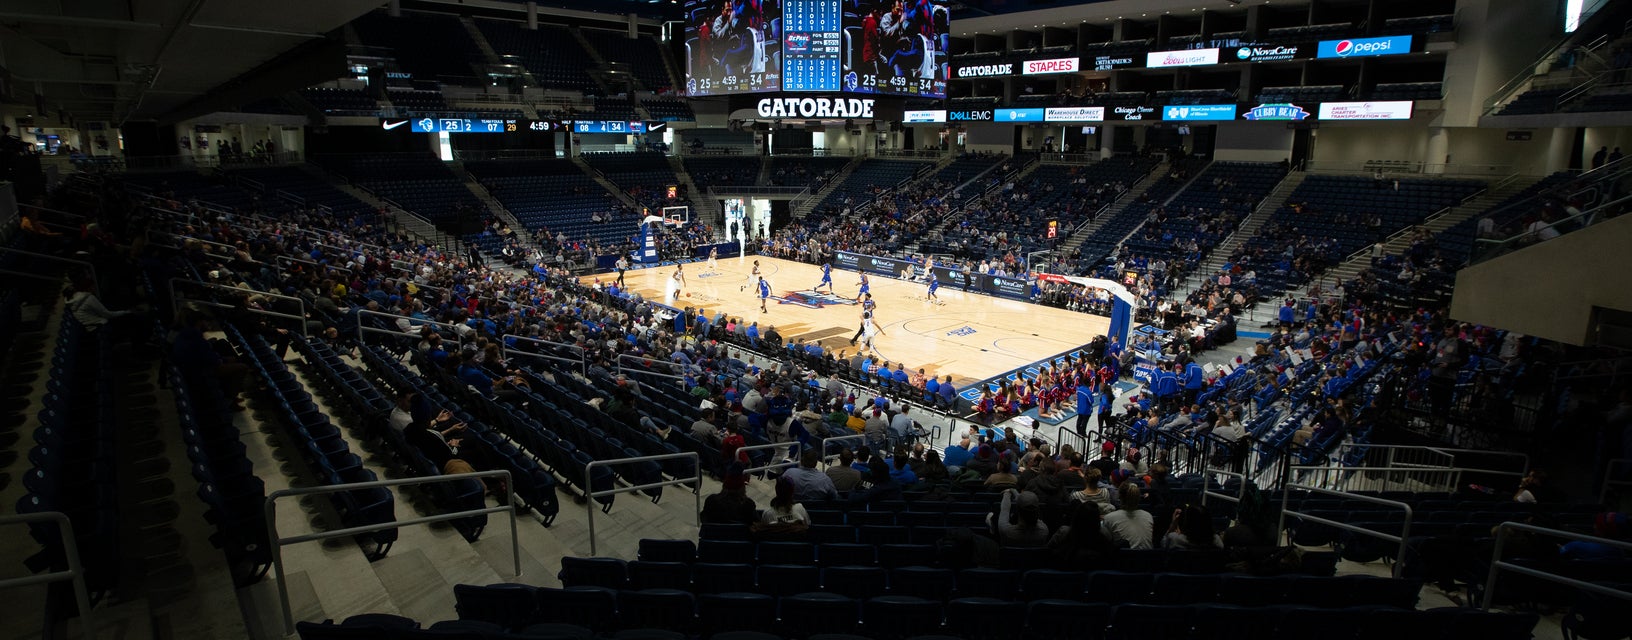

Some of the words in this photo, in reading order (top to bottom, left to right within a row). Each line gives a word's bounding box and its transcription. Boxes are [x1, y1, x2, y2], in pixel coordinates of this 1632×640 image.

[1251, 46, 1297, 56] NovaCare
[1354, 40, 1391, 53] pepsi
[958, 64, 1012, 77] GATORADE
[1030, 60, 1072, 72] STAPLES
[700, 78, 710, 88] 25
[722, 76, 736, 84] 4:59
[750, 74, 762, 86] 34
[862, 74, 876, 86] 25
[890, 76, 906, 86] 4:59
[920, 80, 931, 90] 34
[758, 98, 875, 118] GATORADE
[1254, 108, 1277, 118] CUBBY
[1280, 108, 1298, 118] BEAR
[446, 121, 458, 130] 25
[530, 122, 549, 130] 4:59
[1000, 280, 1024, 288] NovaCare
